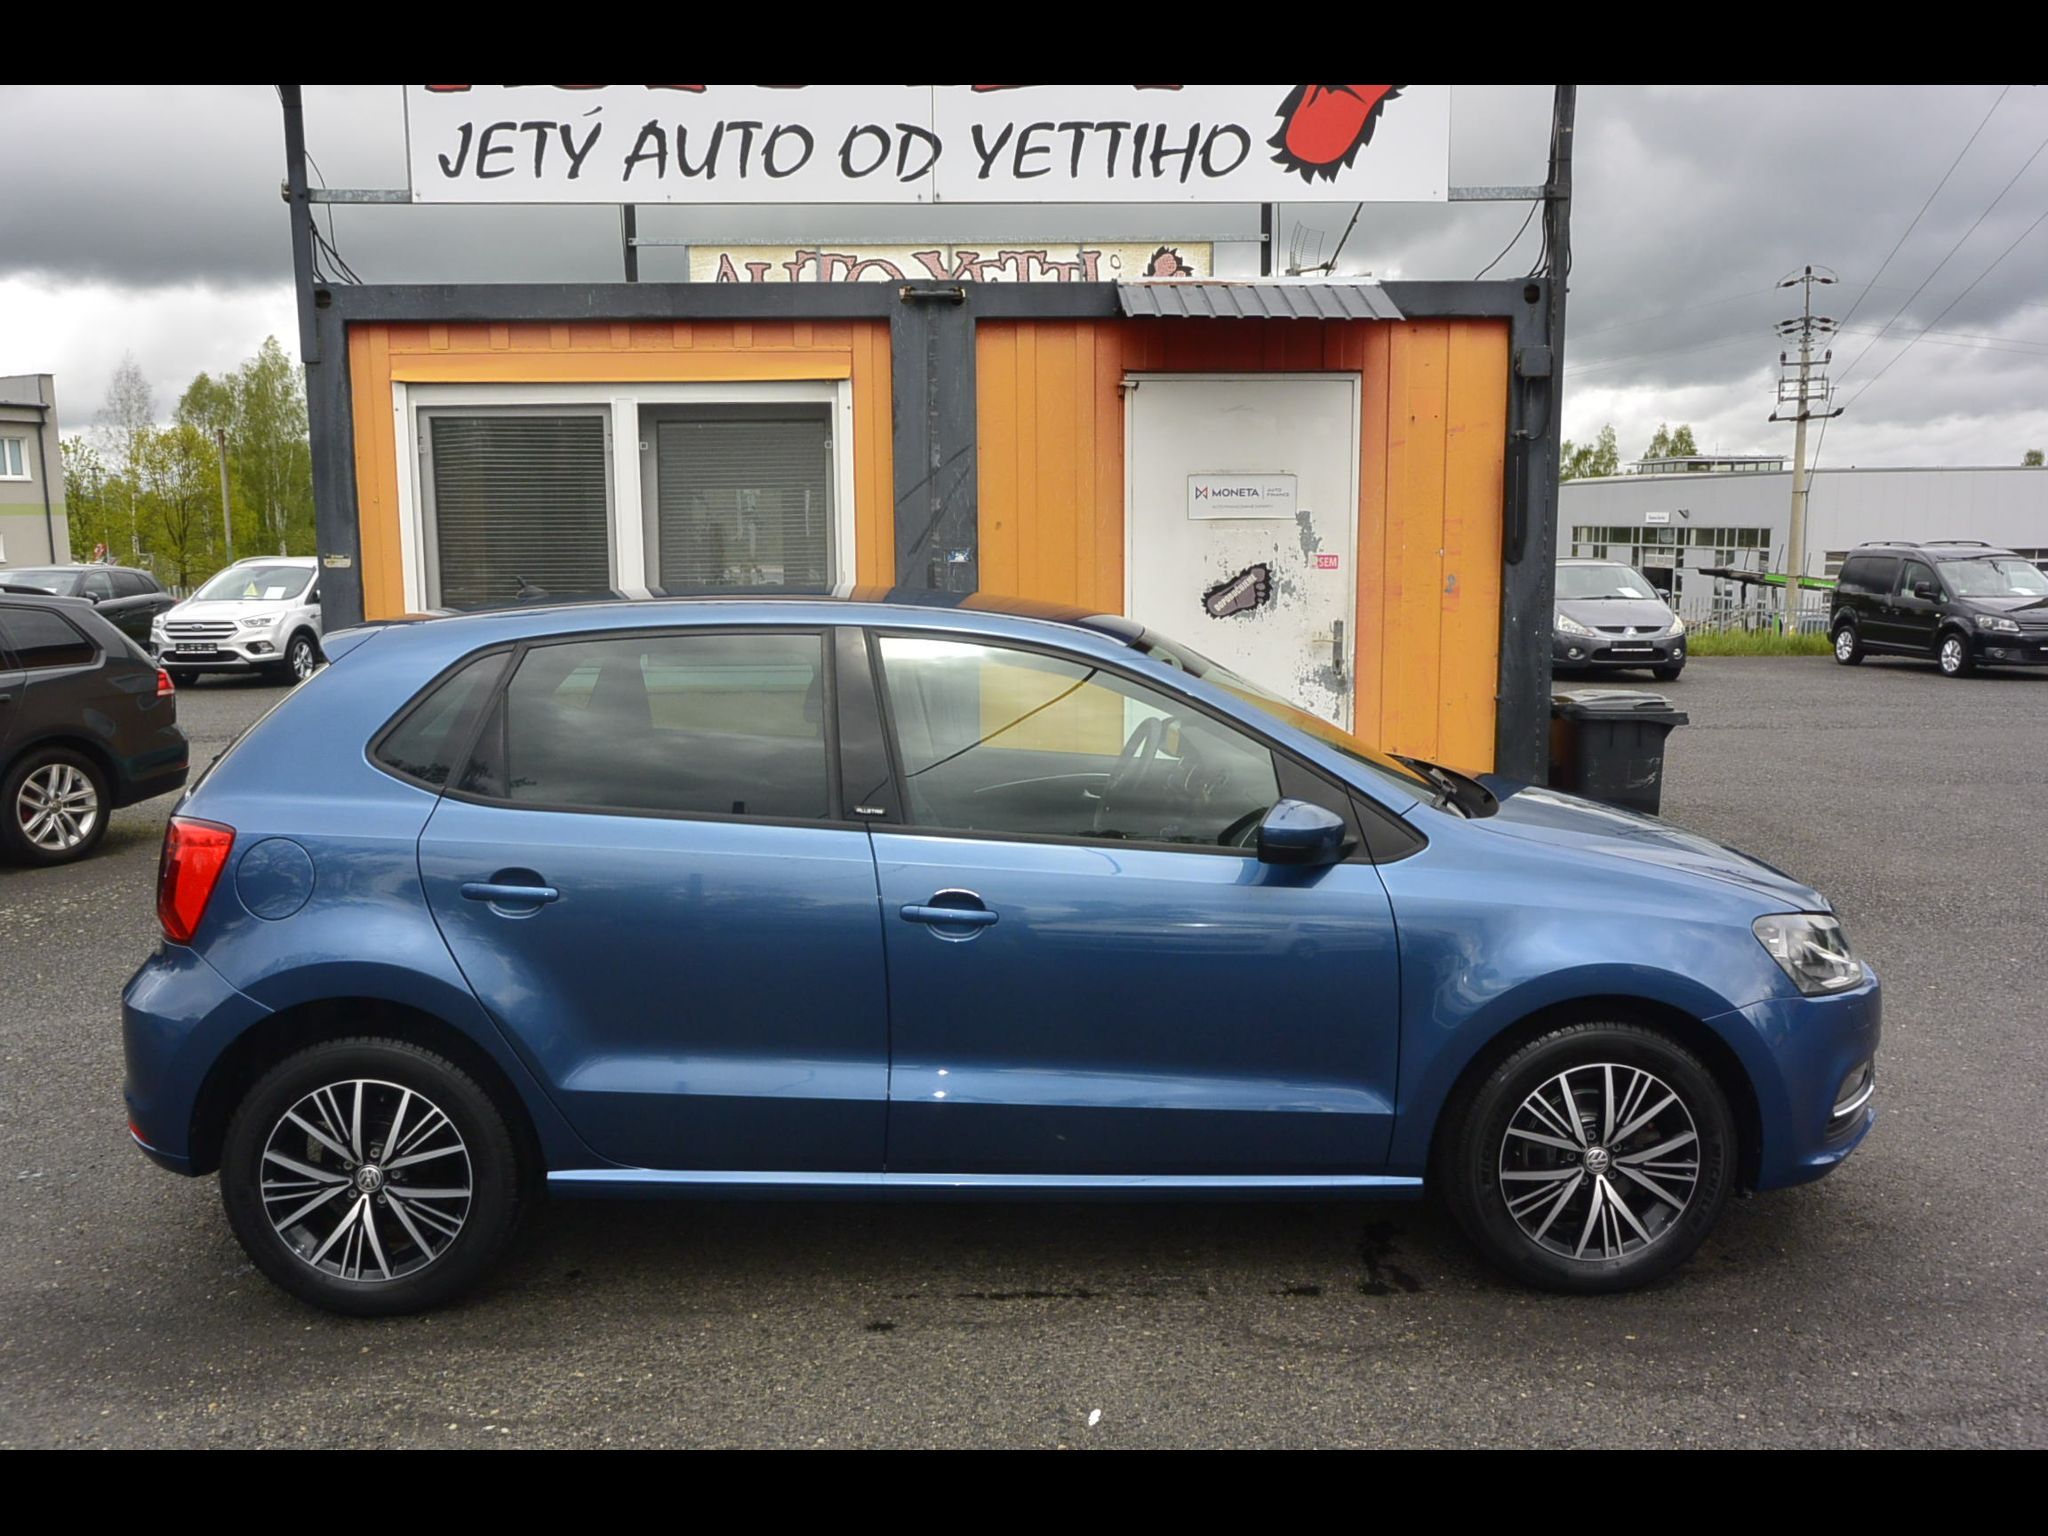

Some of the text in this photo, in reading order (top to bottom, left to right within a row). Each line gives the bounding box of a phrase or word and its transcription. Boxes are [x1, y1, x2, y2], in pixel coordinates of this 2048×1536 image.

[438, 106, 1251, 184] JETÝ AUTO OD YETTIHO
[1211, 487, 1260, 497] MONETA
